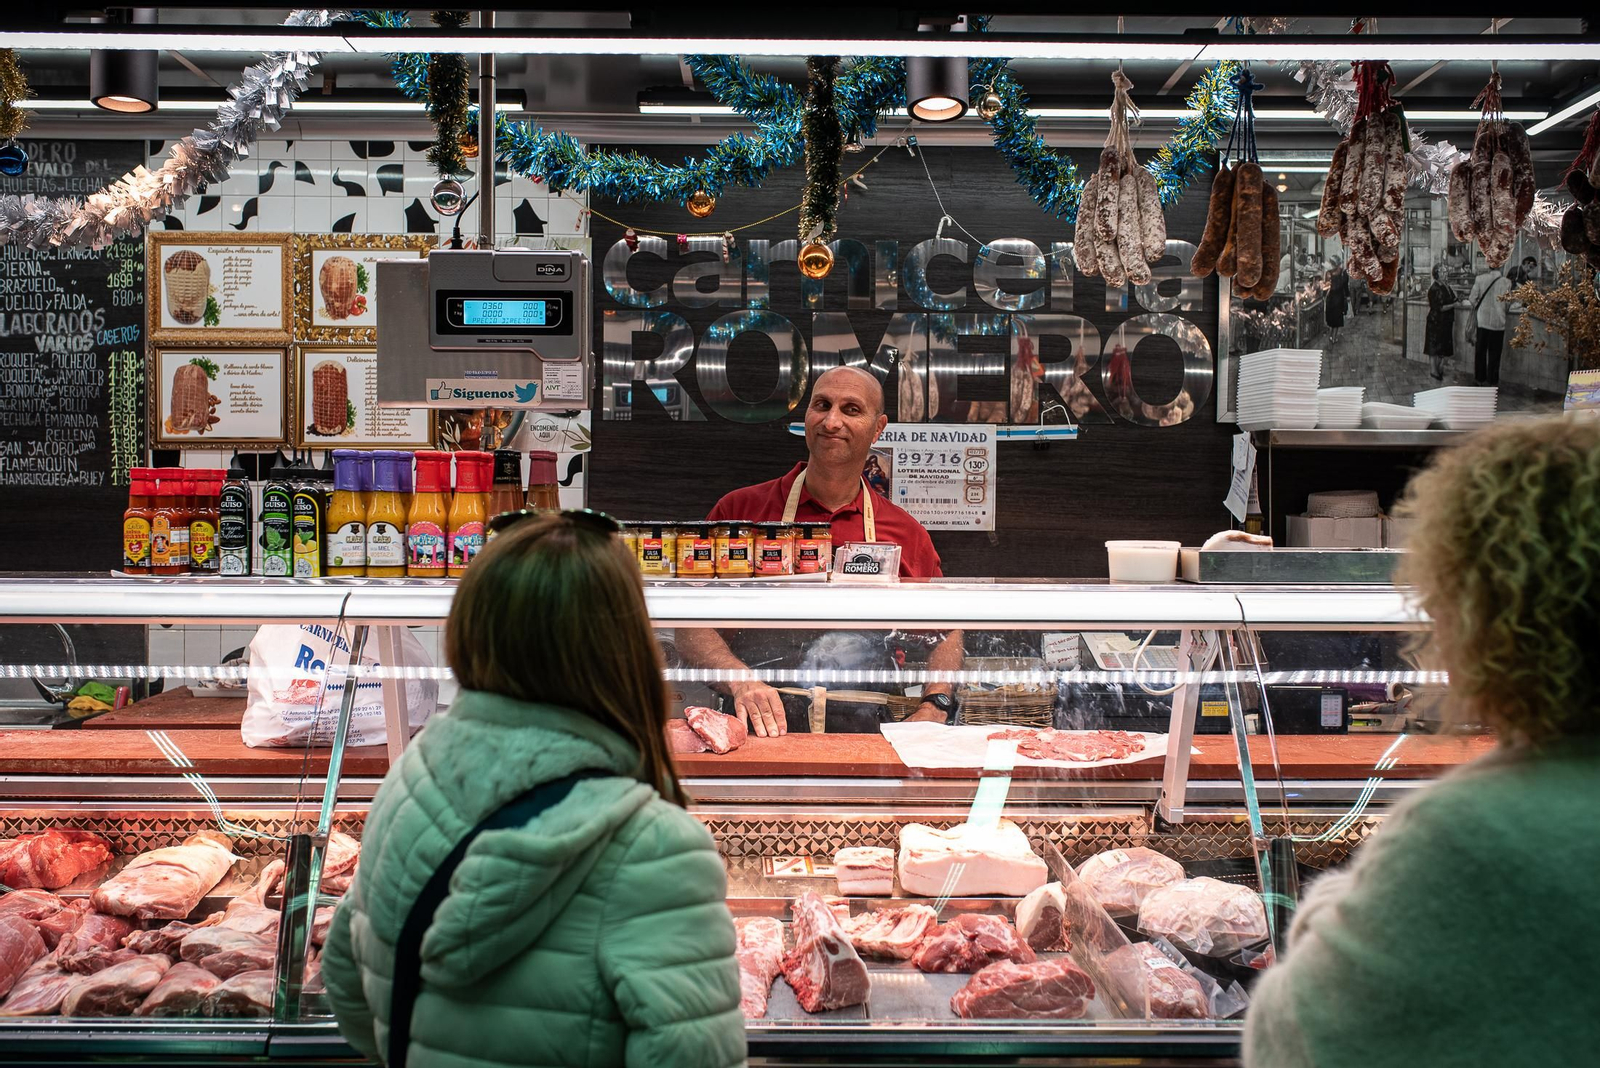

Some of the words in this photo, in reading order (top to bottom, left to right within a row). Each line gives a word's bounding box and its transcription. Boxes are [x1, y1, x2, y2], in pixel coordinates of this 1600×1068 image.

[0, 178, 56, 192] HULETAS
[0, 244, 49, 260] HULETAS
[54, 294, 87, 310] FALDA
[97, 324, 140, 346] CASEROS
[603, 309, 1214, 427] ROMERO
[453, 388, 514, 401] Síguenos
[60, 398, 87, 412] POLLO
[45, 414, 99, 428] EMPANADA
[46, 428, 95, 442] RELLENA
[911, 432, 928, 442] DE
[930, 431, 987, 443] NAVIDAD
[0, 440, 22, 456] SAN
[28, 440, 74, 456] JACOBO
[898, 453, 961, 464] 99716
[80, 471, 105, 486] BUEY
[845, 565, 879, 573] ROMERO
